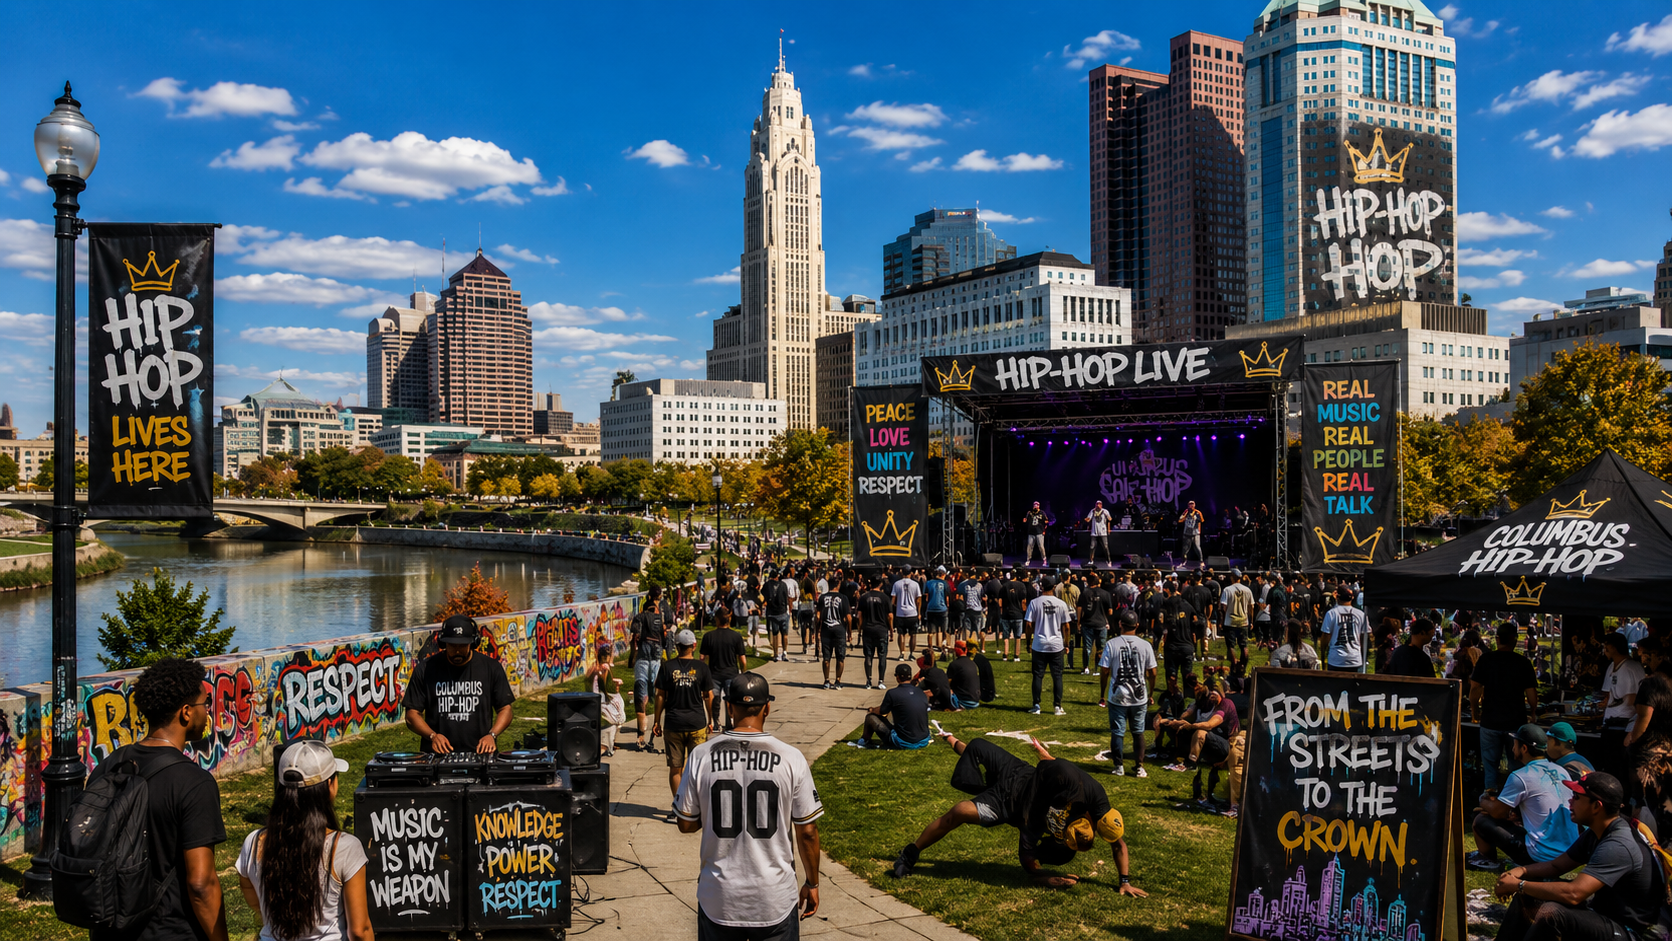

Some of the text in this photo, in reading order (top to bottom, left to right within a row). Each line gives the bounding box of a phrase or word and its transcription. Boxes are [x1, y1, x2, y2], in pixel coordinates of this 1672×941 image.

[1313, 186, 1446, 240] HIP-HOP
[1320, 238, 1444, 301] HOP
[101, 293, 195, 351] HIP
[101, 349, 204, 410] HOP
[995, 347, 1211, 391] HIP-HOP LIVE
[1322, 379, 1376, 400] REAL
[865, 402, 916, 424] PEACE
[1317, 402, 1381, 423] MUSIC
[111, 415, 192, 448] LIVES
[869, 427, 911, 447] LOVE
[1323, 425, 1374, 446] REAL
[111, 449, 192, 485] HERE
[866, 451, 914, 472] UNITY
[1312, 448, 1385, 469] PEOPLE
[857, 475, 924, 495] RESPECT
[1322, 471, 1375, 492] REAL
[1323, 495, 1374, 515] TALK
[1458, 547, 1625, 577] HIP-HOP
[282, 654, 400, 731] RESPECT
[435, 680, 483, 696] COLUMBUS
[437, 696, 480, 713] HIP-HOP
[1263, 690, 1419, 736] FROM THE
[709, 750, 781, 773] HIP-HOP
[1288, 732, 1441, 775] STREETS
[710, 779, 780, 839] 00
[1294, 777, 1398, 818] TO THE
[369, 806, 444, 843] MUSIC
[474, 807, 564, 844] KNOWLEDGE
[407, 840, 439, 872] MY
[485, 843, 557, 878] POWER
[369, 869, 451, 909] WEAPON
[478, 879, 562, 914] RESPECT
